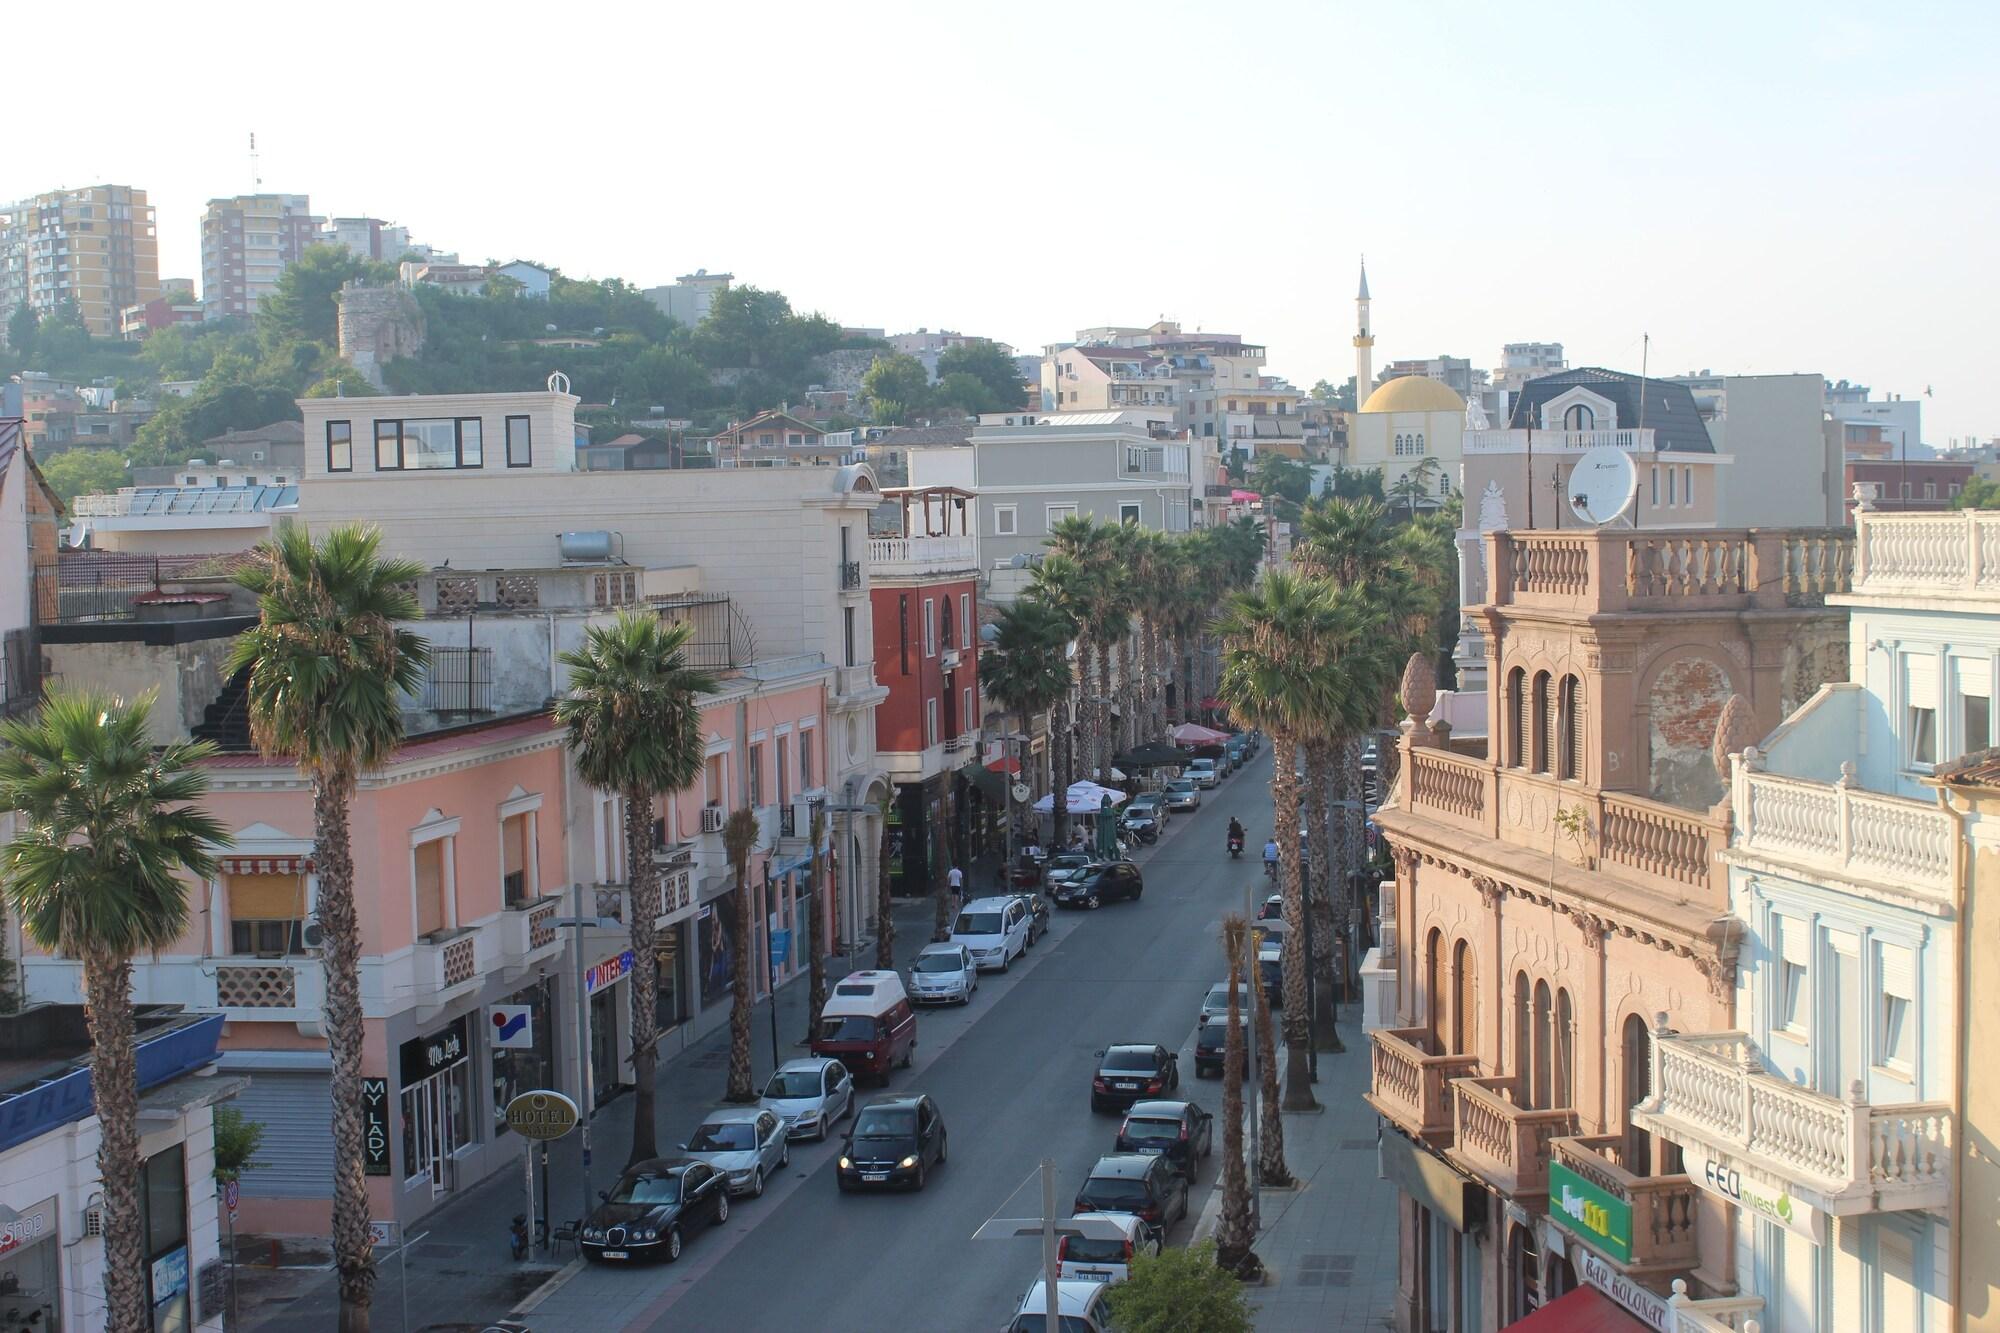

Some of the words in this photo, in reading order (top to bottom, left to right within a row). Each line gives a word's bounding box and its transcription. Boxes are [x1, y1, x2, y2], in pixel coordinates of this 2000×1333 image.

[362, 1081, 385, 1106] MY
[511, 1110, 573, 1125] HOTEL
[368, 1112, 385, 1161] LADY
[1586, 1258, 1608, 1290] BAR
[1611, 1276, 1666, 1328] KOLONAT
